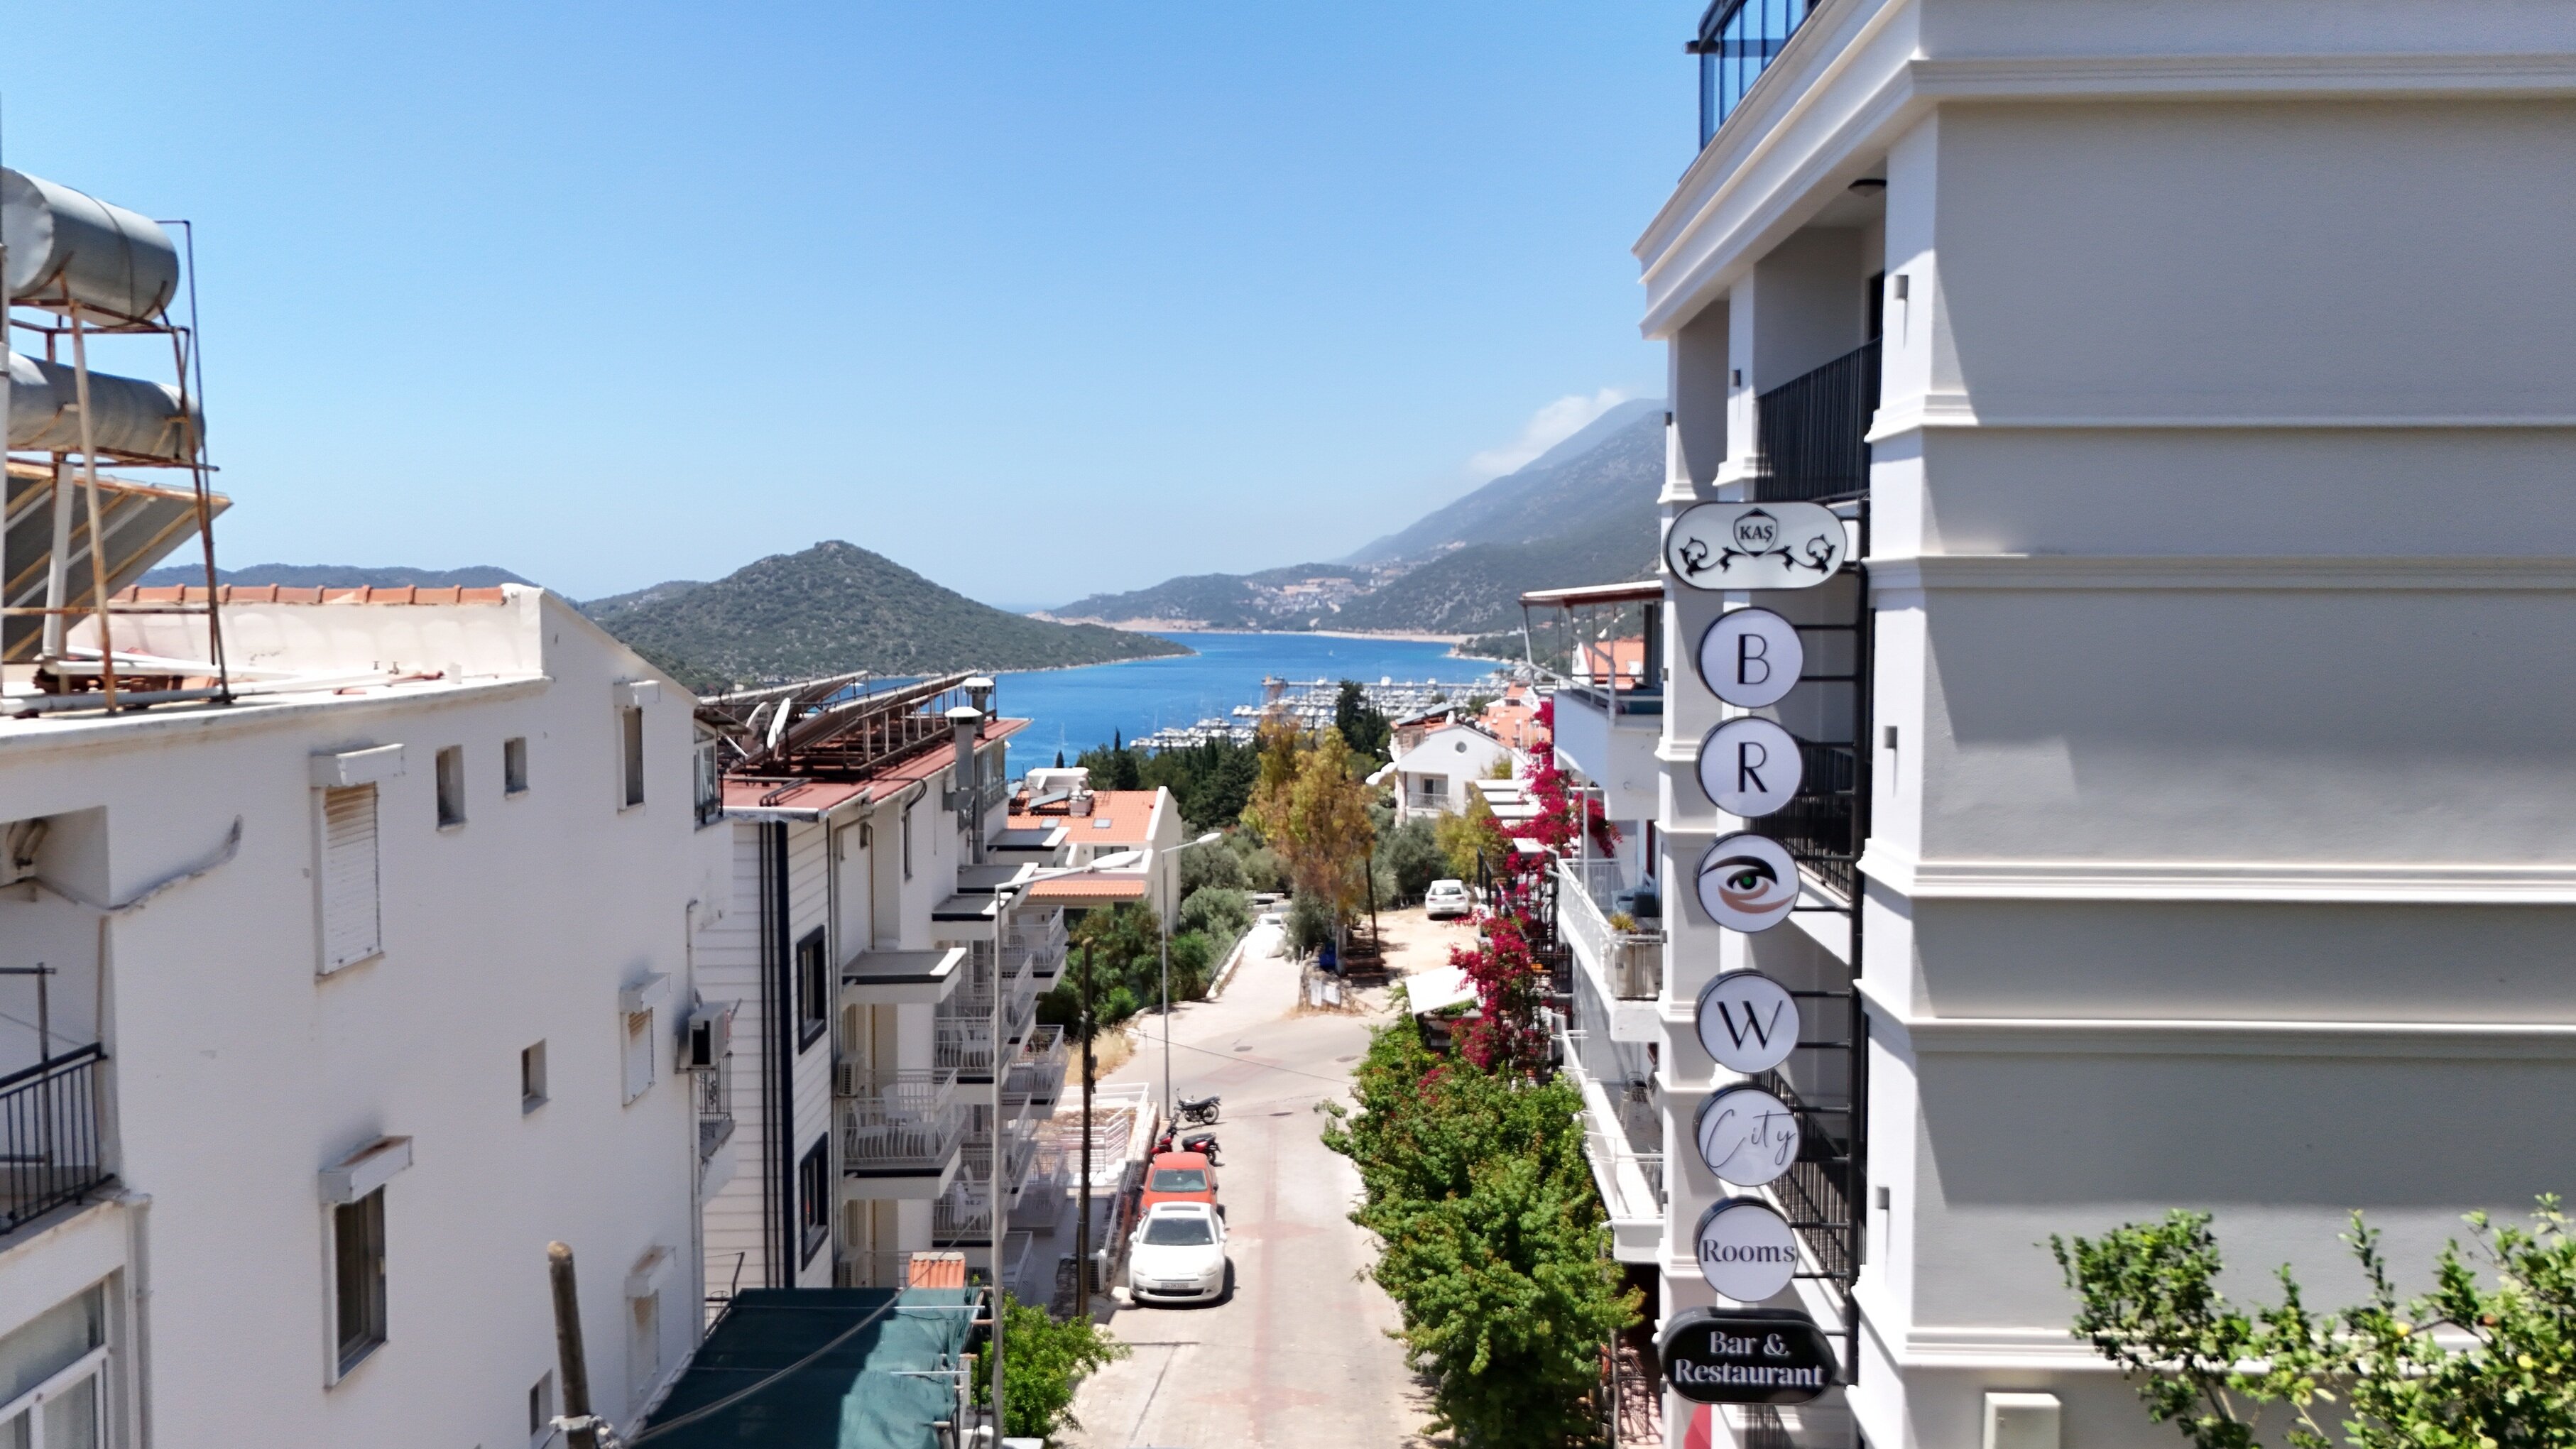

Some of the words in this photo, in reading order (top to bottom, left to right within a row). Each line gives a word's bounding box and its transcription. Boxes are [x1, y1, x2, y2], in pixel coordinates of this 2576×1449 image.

[1740, 525, 1773, 542] KAŞ
[1705, 1108, 1796, 1169] City
[1703, 1239, 1796, 1262] Rooms
[1710, 1331, 1757, 1354] Bar
[1763, 1333, 1790, 1355] &
[1675, 1359, 1825, 1385] Restaurant
